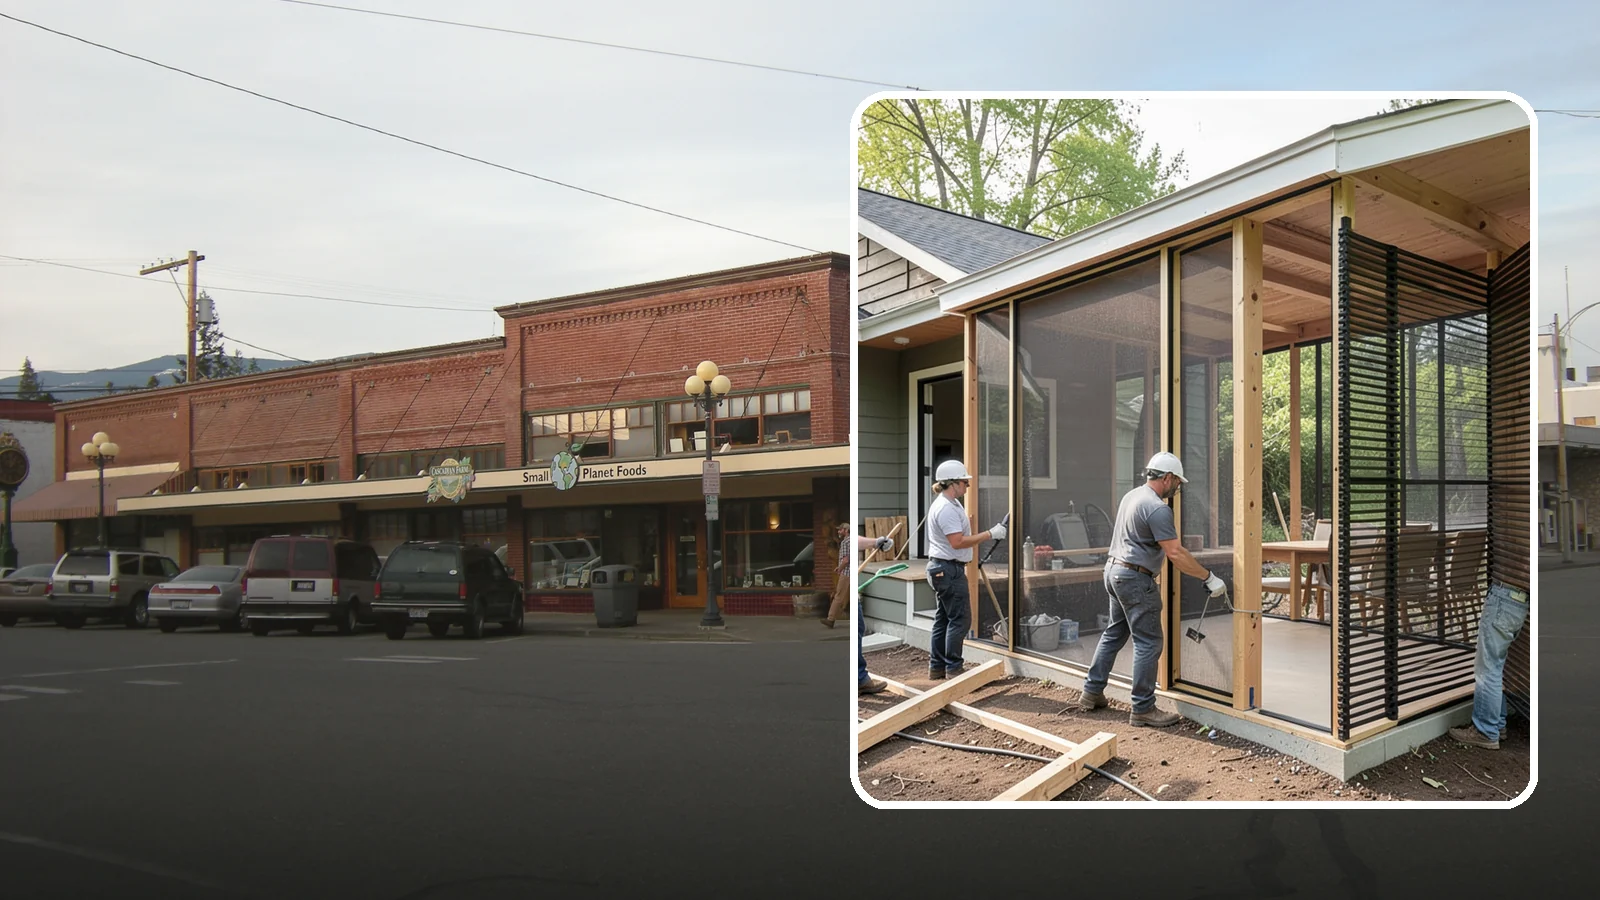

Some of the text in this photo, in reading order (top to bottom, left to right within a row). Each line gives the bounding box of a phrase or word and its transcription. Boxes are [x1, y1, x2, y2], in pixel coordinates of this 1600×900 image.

[456, 466, 469, 474] FARM
[523, 464, 647, 483] Small Planet Foods
